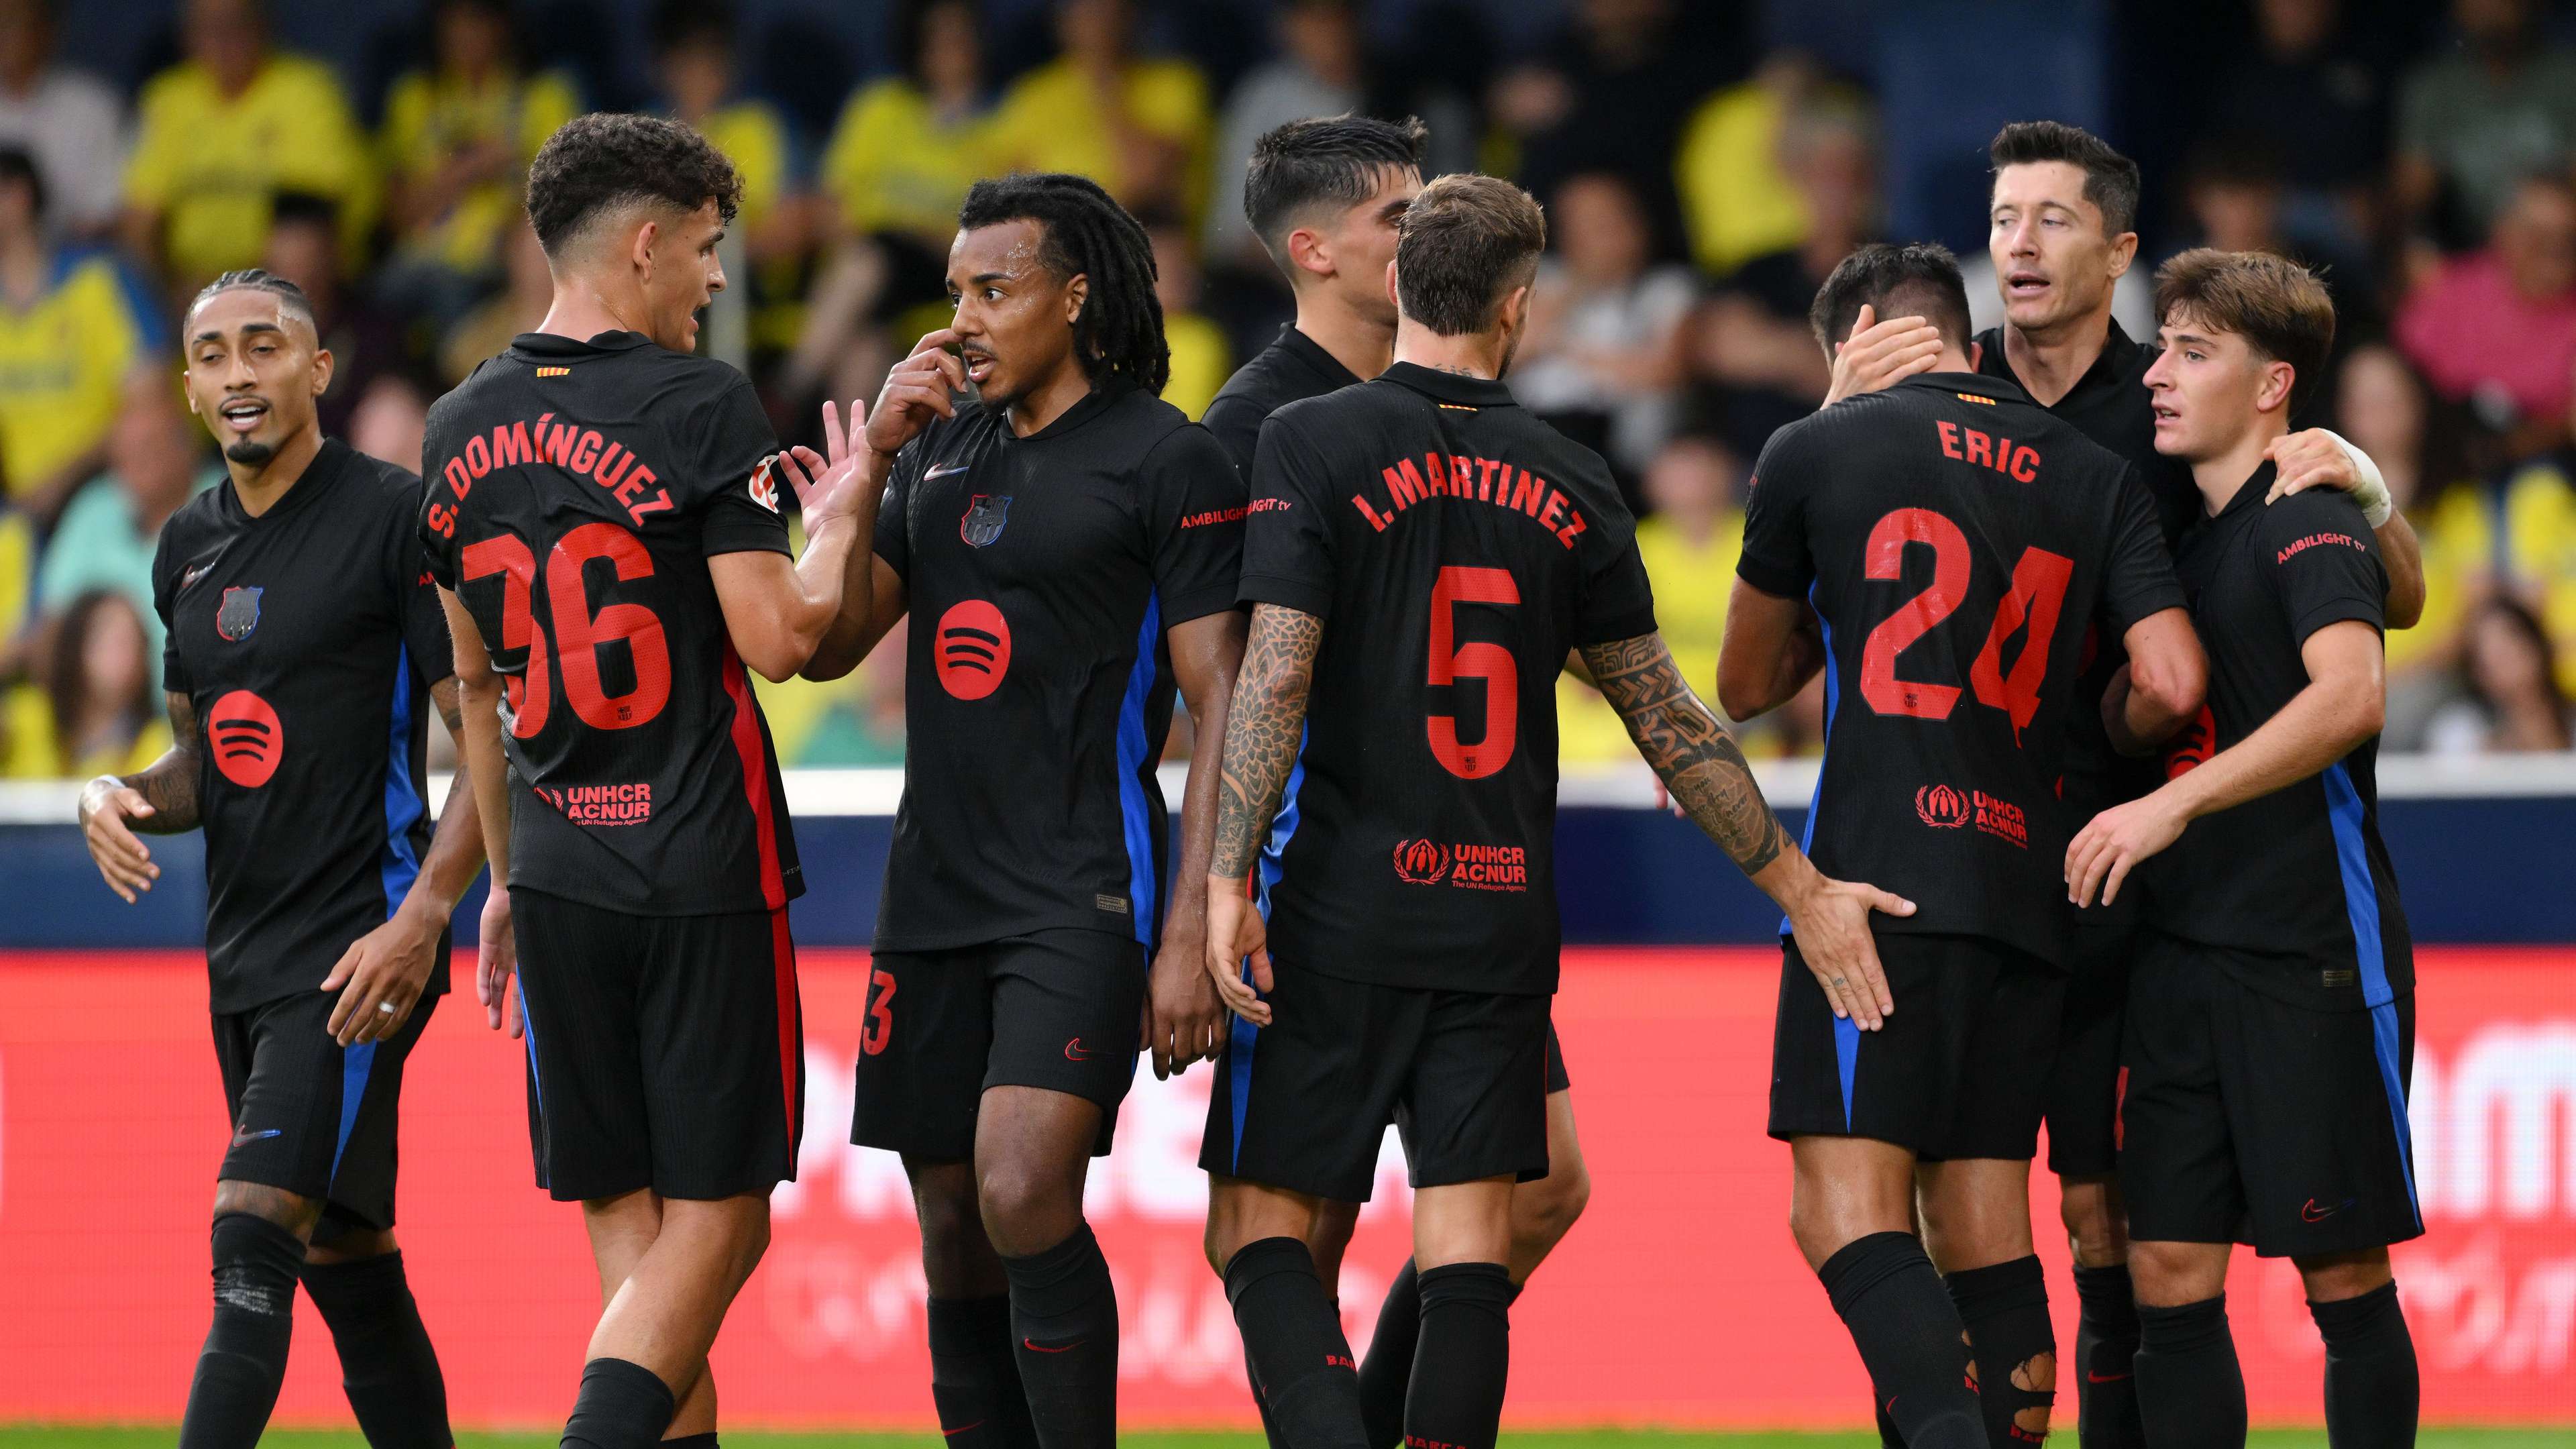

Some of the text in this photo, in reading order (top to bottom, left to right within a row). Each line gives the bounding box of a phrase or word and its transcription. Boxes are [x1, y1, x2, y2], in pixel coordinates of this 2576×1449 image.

[1937, 420, 2041, 483] ERIC
[2277, 533, 2352, 564] AMBILIGHT
[1860, 507, 2074, 749] 24
[1427, 565, 1521, 780] 5
[568, 784, 651, 804] UNHCR
[568, 802, 651, 820] ACNUR
[1975, 808, 2028, 842] ACNUR
[1454, 843, 1525, 865] UNHCR
[1451, 863, 1527, 883] ACNUR
[1451, 880, 1465, 888] The
[1478, 883, 1505, 892] Refugee
[863, 969, 898, 1056] 3
